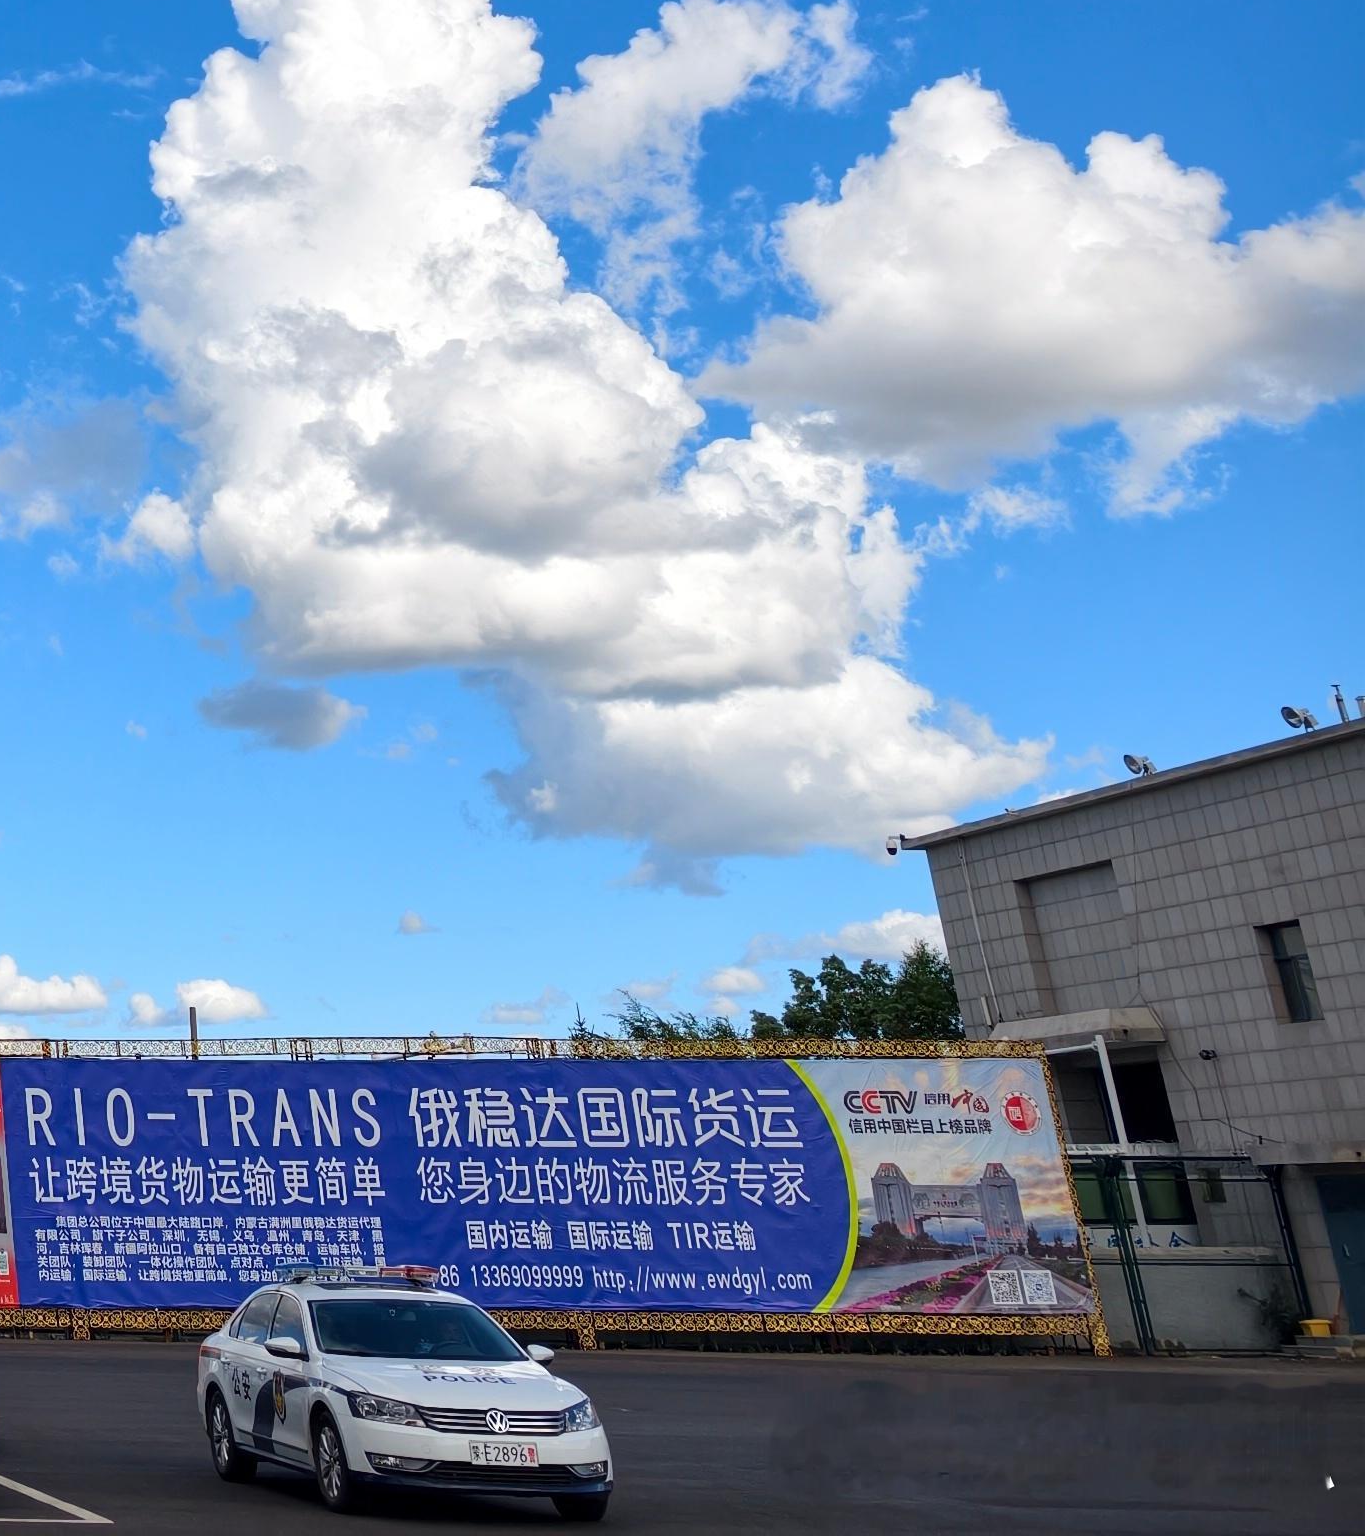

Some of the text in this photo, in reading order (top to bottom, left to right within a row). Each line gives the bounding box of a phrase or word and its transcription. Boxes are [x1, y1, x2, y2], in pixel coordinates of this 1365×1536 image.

[24, 1087, 381, 1147] RIO-TRANS
[408, 1087, 804, 1148] 俄稳达国际货运
[843, 1090, 917, 1114] CCTV
[849, 1118, 993, 1134] 信用中国栏目上榜品牌
[29, 1155, 385, 1206] 让跨境货物运输更简单
[416, 1157, 810, 1206] 您身边的物流服务专家
[466, 1220, 757, 1251] 国内运输 国际运输 TIR运输
[471, 1265, 584, 1289] 13369099999
[232, 1366, 251, 1400] 公安
[422, 1375, 517, 1385] POLICE
